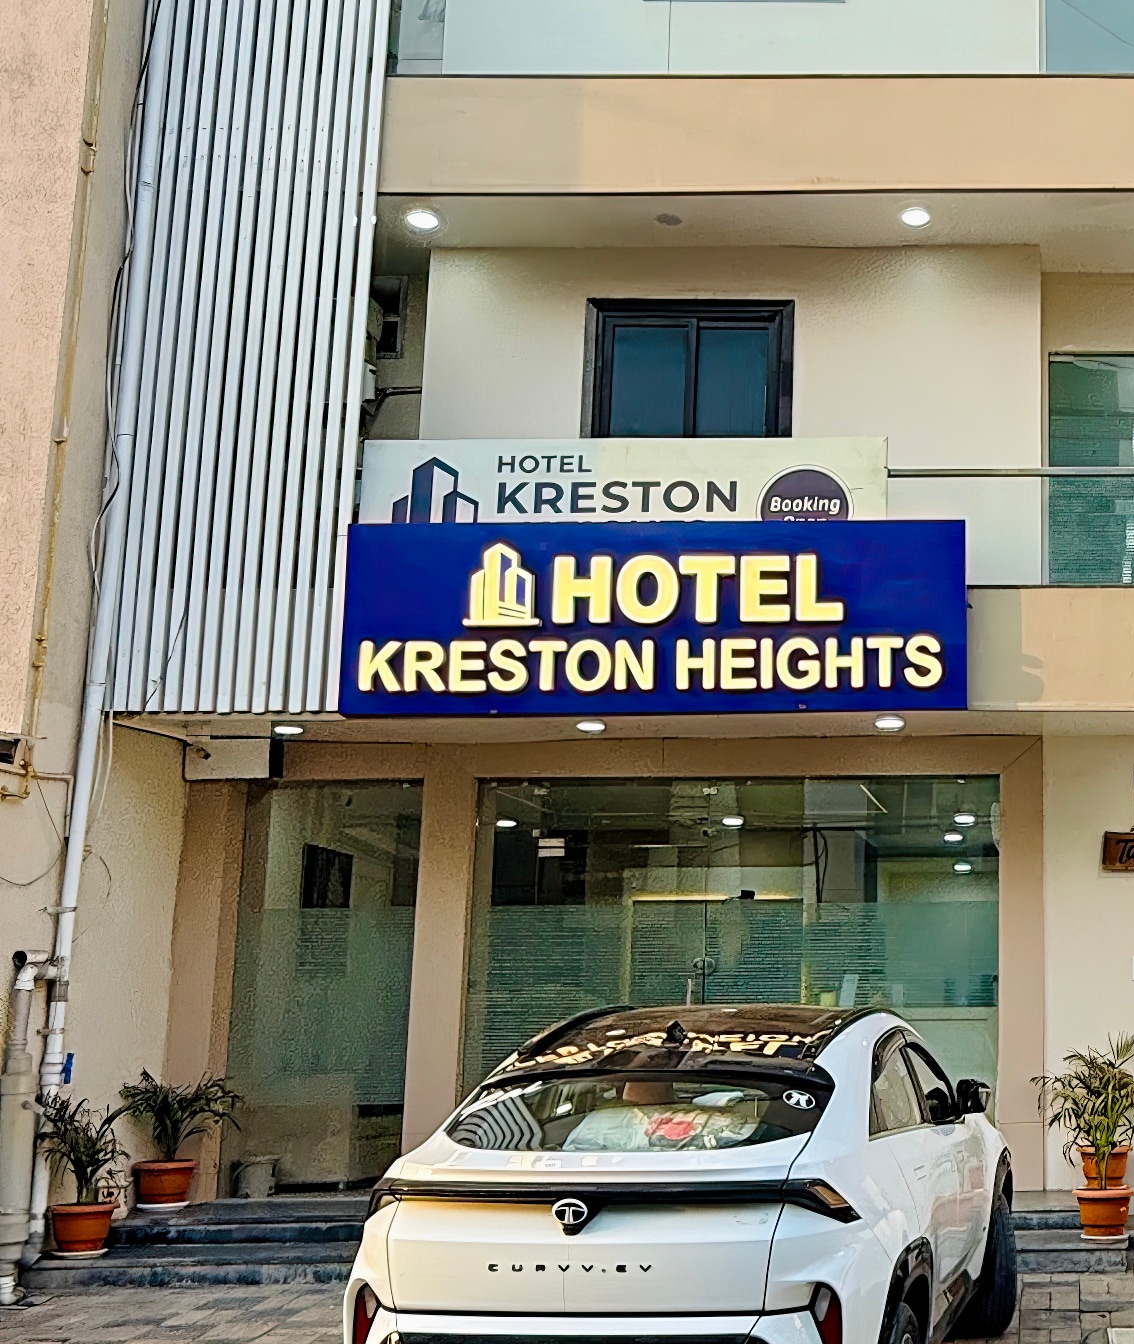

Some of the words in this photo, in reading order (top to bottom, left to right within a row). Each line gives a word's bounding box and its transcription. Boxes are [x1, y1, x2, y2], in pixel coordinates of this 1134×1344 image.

[497, 454, 593, 474] HOTEL
[497, 480, 738, 515] KRESTON
[769, 495, 841, 516] Booking
[551, 554, 845, 625] HOTEL
[358, 639, 655, 693] KRESTON
[676, 634, 943, 692] HEIGHTS
